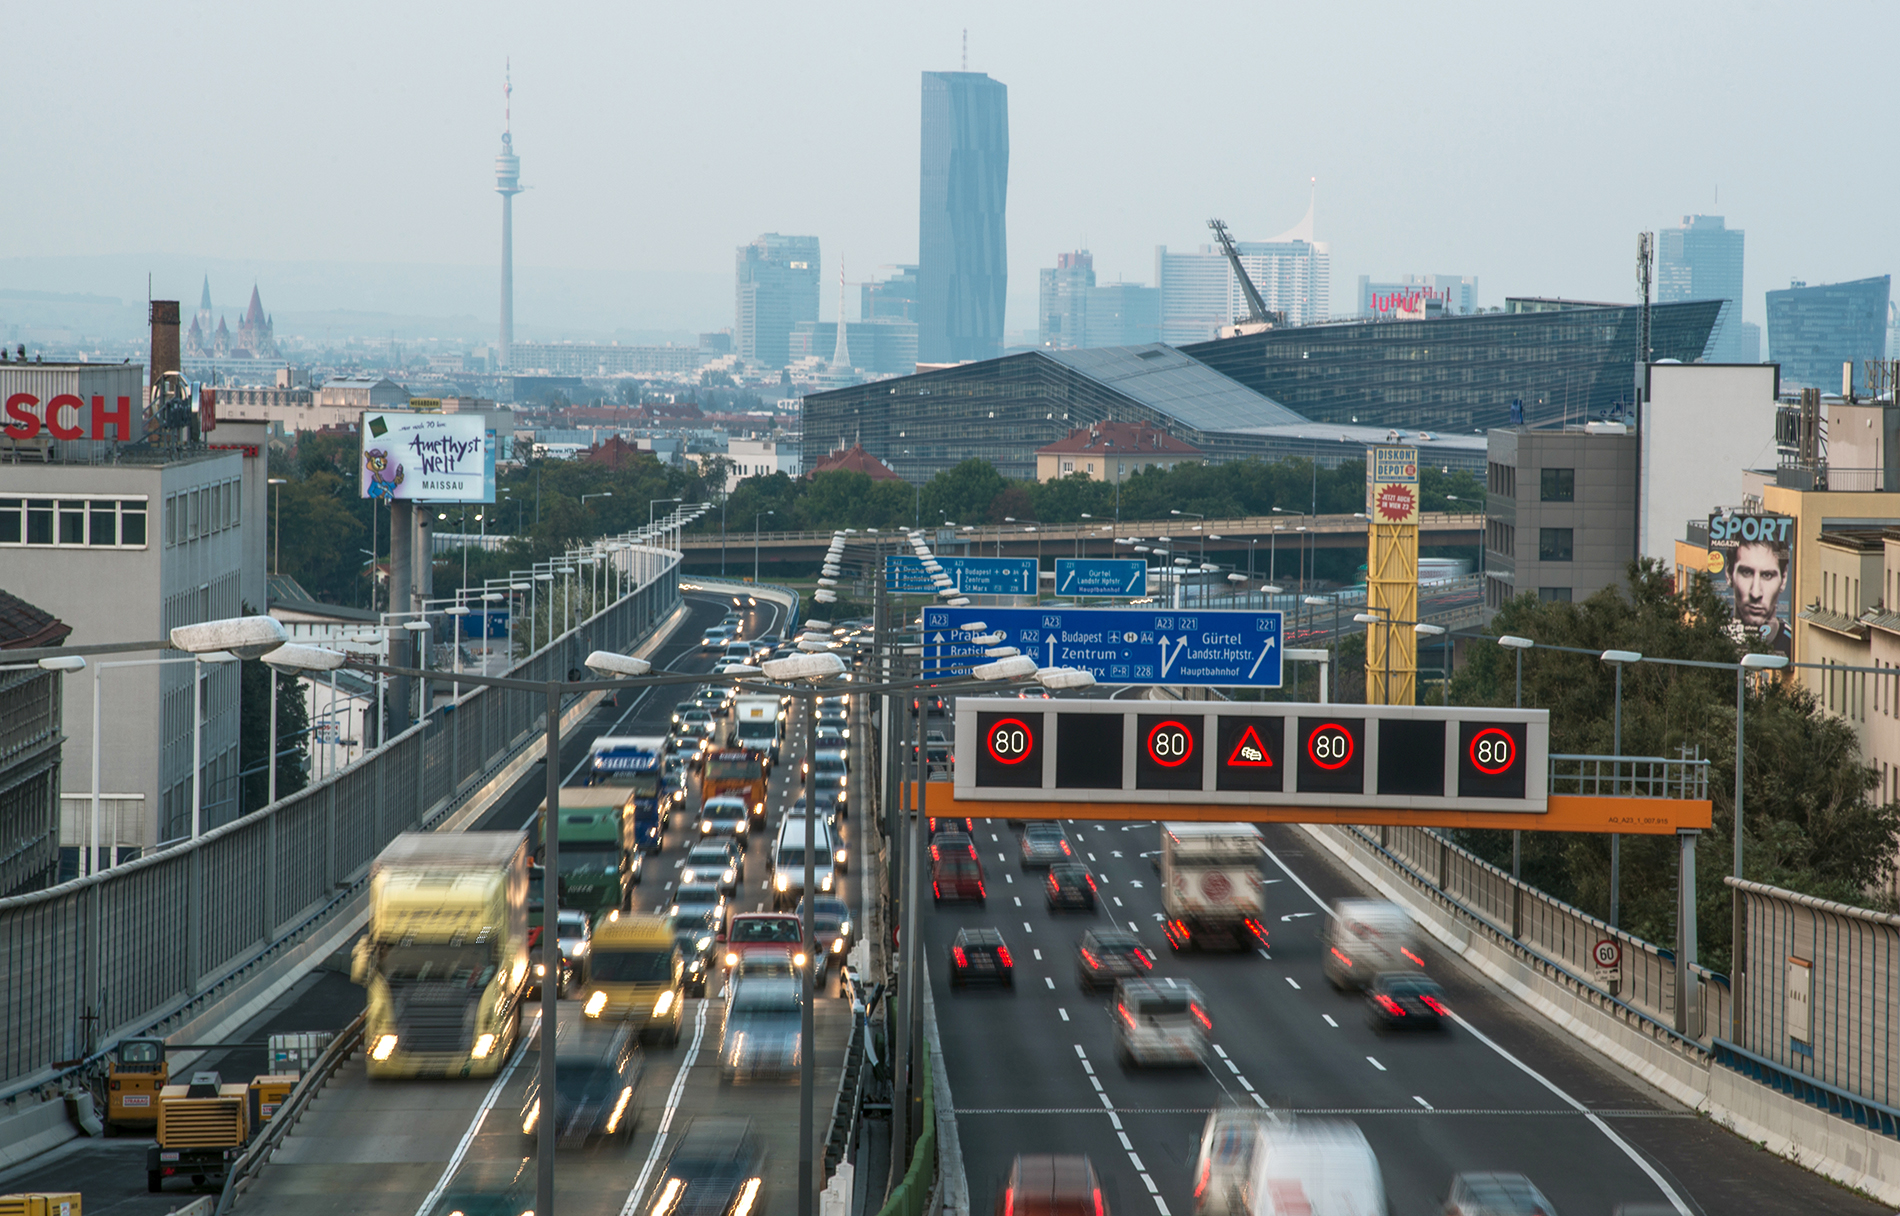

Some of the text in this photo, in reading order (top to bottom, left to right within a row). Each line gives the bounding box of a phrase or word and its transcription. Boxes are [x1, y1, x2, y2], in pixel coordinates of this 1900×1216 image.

[1370, 293, 1418, 312] JUHU!
[3, 392, 131, 441] SCH
[408, 433, 482, 462] Amethyst
[1378, 450, 1416, 460] DISKONT
[421, 453, 455, 475] Welt
[1378, 465, 1404, 475] DEPOT
[422, 481, 464, 490] MAISSAU
[1709, 516, 1792, 541] SPORT
[1711, 540, 1740, 548] MAGAZIN
[965, 567, 992, 576] Budapest
[931, 615, 947, 626] A23
[1044, 616, 1060, 627] A23
[1157, 618, 1196, 629] A23 221
[1259, 620, 1274, 630] 221
[1022, 631, 1039, 641] A22
[1061, 631, 1102, 645] Budapest
[1141, 632, 1153, 643] A4
[1202, 632, 1242, 645] Gürtel
[1027, 648, 1039, 657] A4
[1061, 647, 1116, 660] Zentrum
[1187, 648, 1255, 662] Landstr.Hptstr.
[1136, 666, 1152, 677] 228
[1180, 667, 1240, 678] Hauptbahnhof
[995, 730, 1024, 753] 80
[1155, 733, 1184, 756] 80
[1316, 735, 1345, 759] 80
[1478, 740, 1507, 764] 80
[1600, 947, 1614, 961] 60
